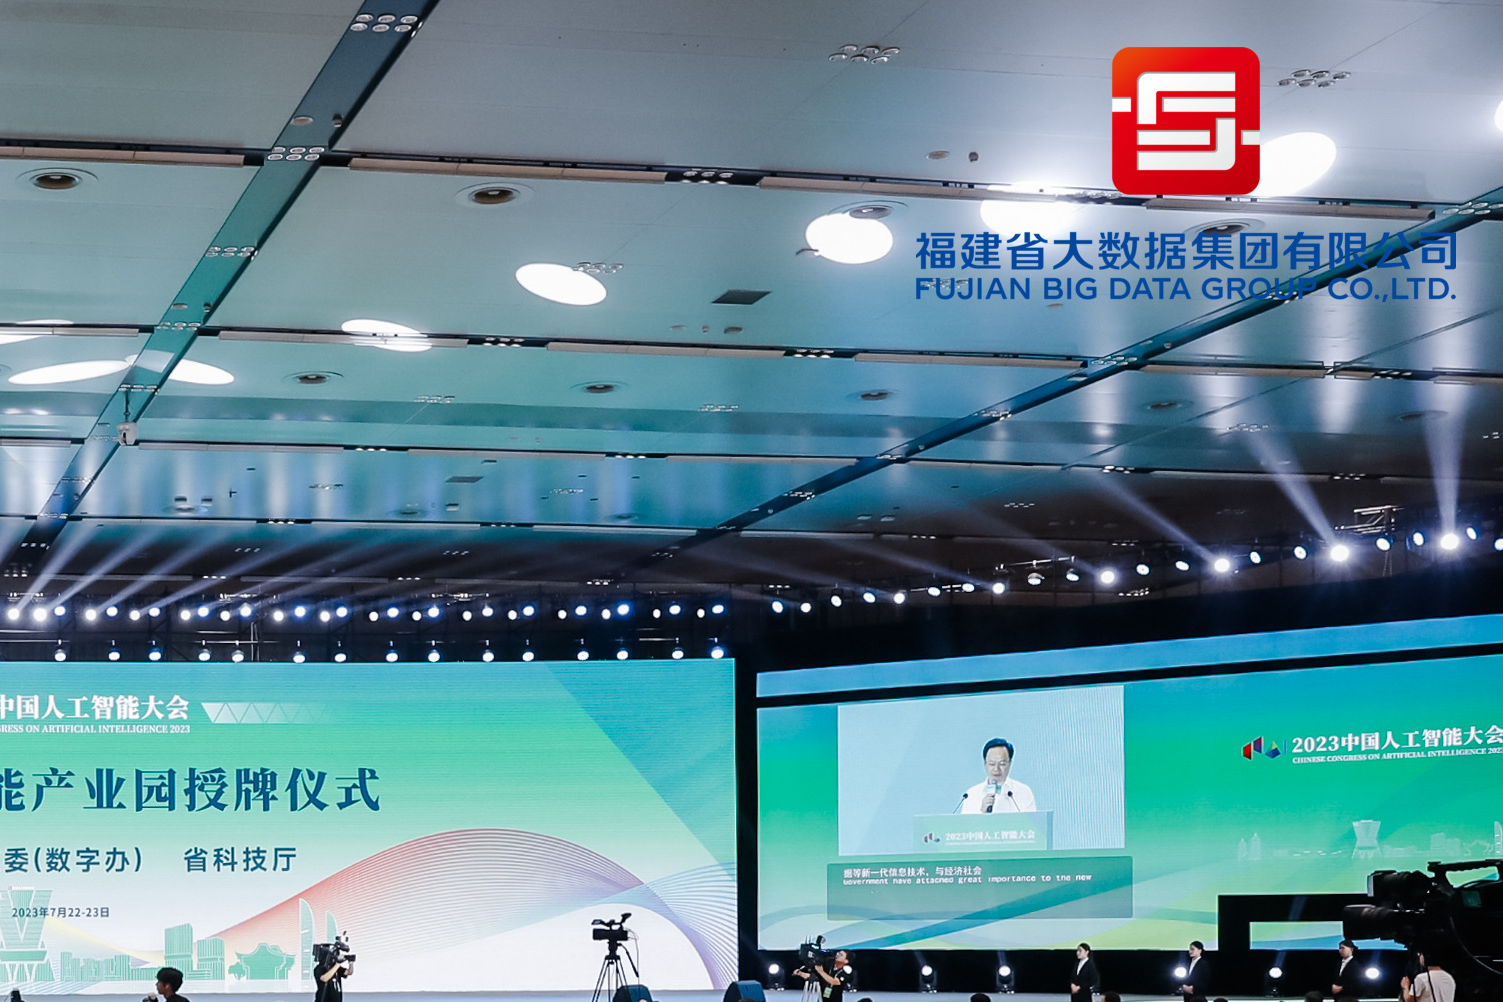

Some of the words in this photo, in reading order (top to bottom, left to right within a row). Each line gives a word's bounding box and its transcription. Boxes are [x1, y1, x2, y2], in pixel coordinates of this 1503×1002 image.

[26, 724, 40, 733] ON
[42, 724, 96, 733] ARTIFICIAL
[99, 724, 168, 733] INTELLIGENCE
[170, 724, 191, 733] 2023
[183, 847, 297, 873] 省科技厅
[12, 907, 110, 919] 2023年7月22-23日
